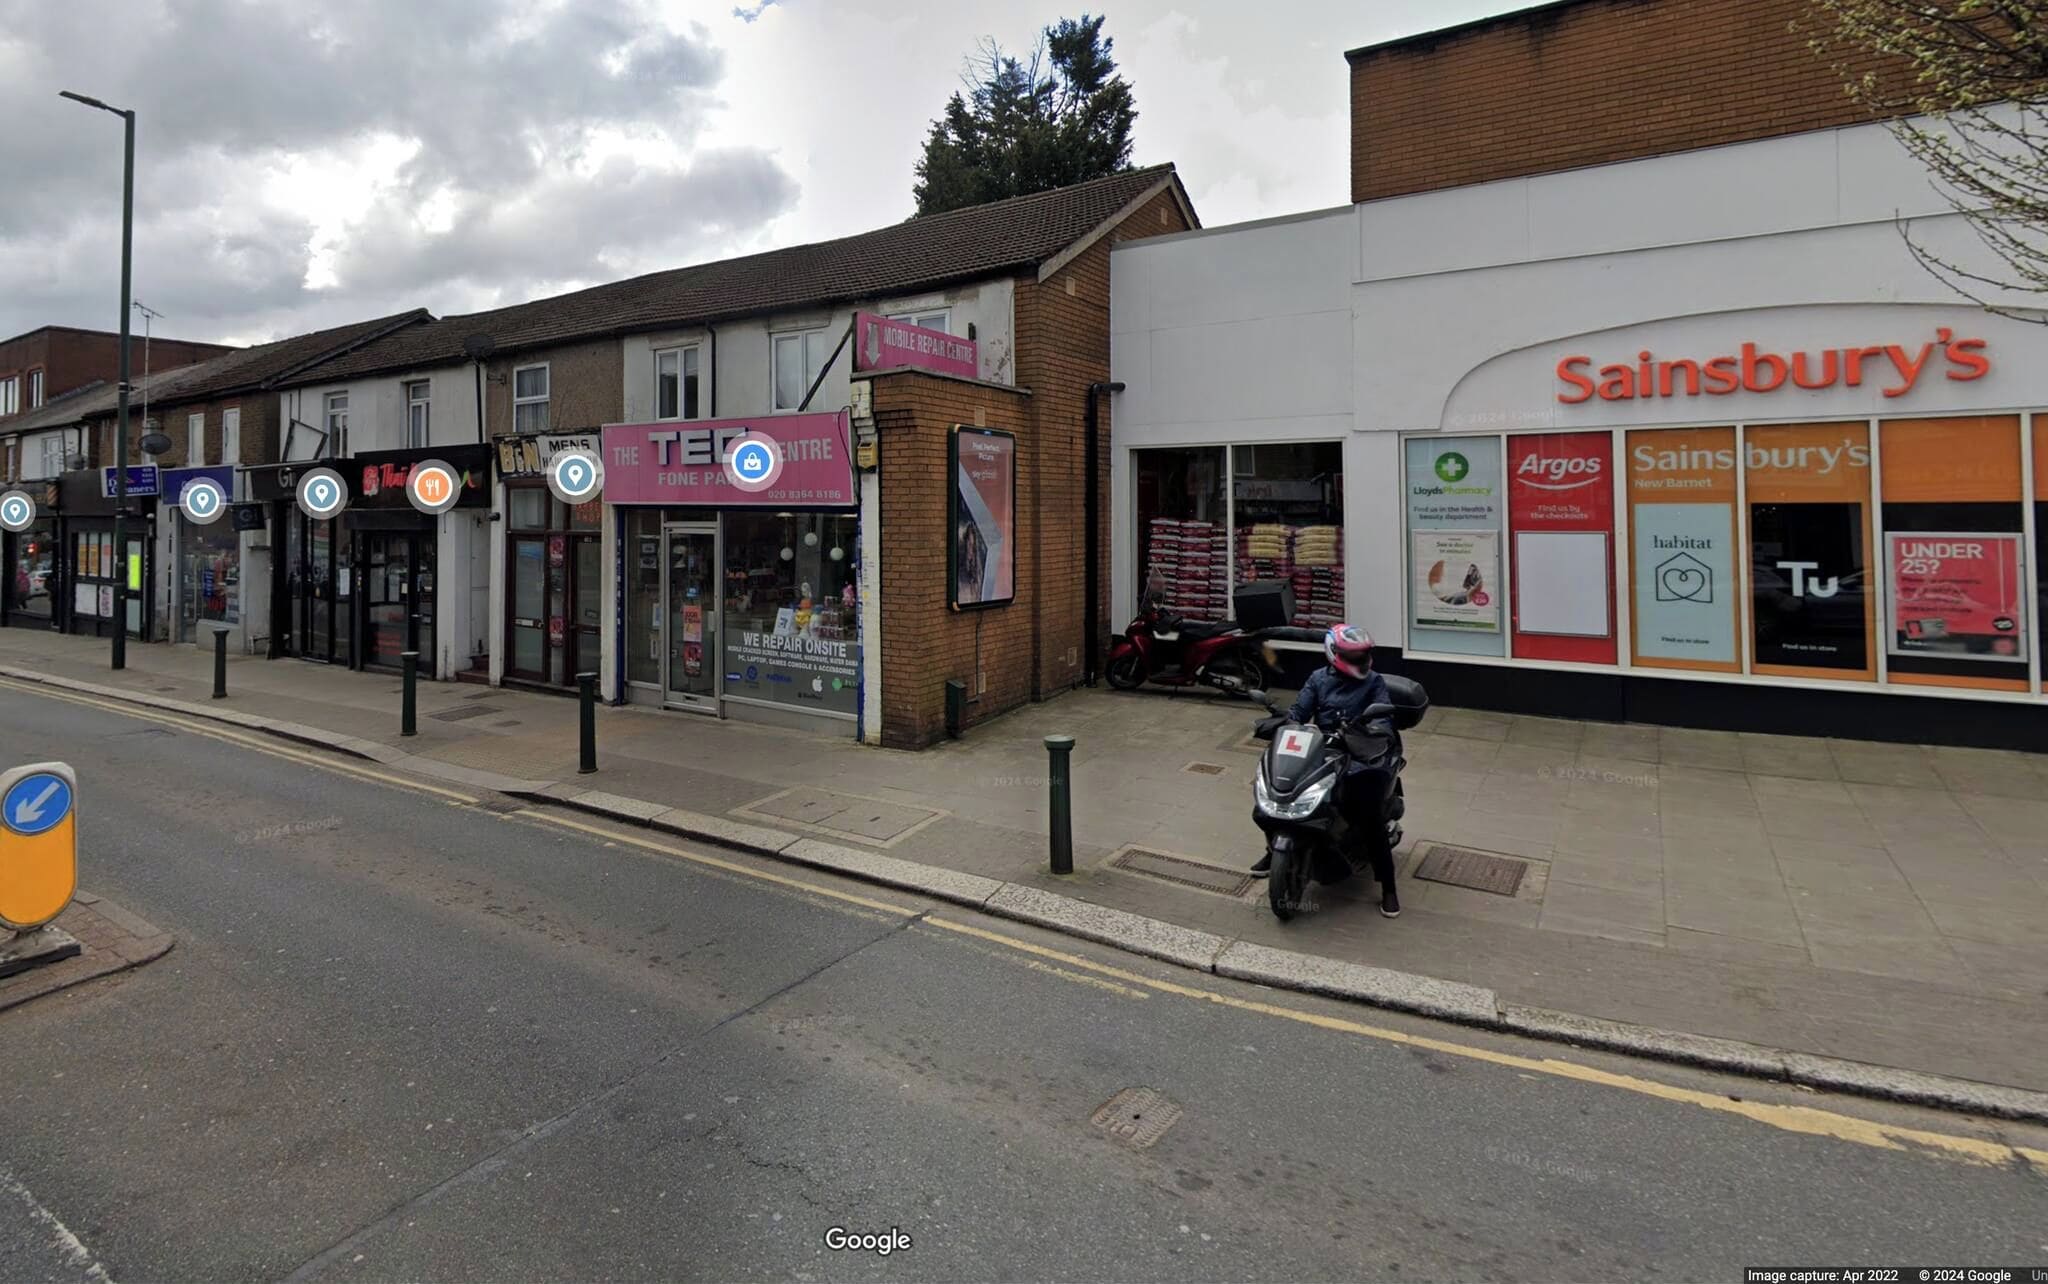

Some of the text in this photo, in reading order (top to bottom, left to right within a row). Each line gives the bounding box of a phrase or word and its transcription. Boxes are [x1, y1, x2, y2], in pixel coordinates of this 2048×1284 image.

[884, 326, 973, 364] MOBILE REPAIR CENTRE
[1556, 327, 1990, 404] Sainsbury's
[549, 438, 590, 452] MENS
[613, 446, 639, 466] THE
[1634, 439, 1870, 474] Sainsbury's
[1517, 453, 1602, 480] Argos
[658, 471, 699, 486] FONE
[1634, 477, 1713, 488] New Barnet
[768, 491, 786, 500] 020
[1413, 485, 1492, 497] LloydsPharmacy
[1538, 504, 1557, 512] Find
[1568, 505, 1580, 513] by
[1545, 512, 1589, 520] checkouts
[1419, 513, 1487, 521] beauty department
[1653, 535, 1713, 550] habitat
[1901, 542, 1984, 559] UNDER
[1901, 559, 1941, 575] 25?
[1776, 561, 1840, 598] Tu
[743, 631, 847, 658] WE REPAIR ONSITE
[1782, 642, 1798, 650] Find
[1286, 735, 1303, 752] L
